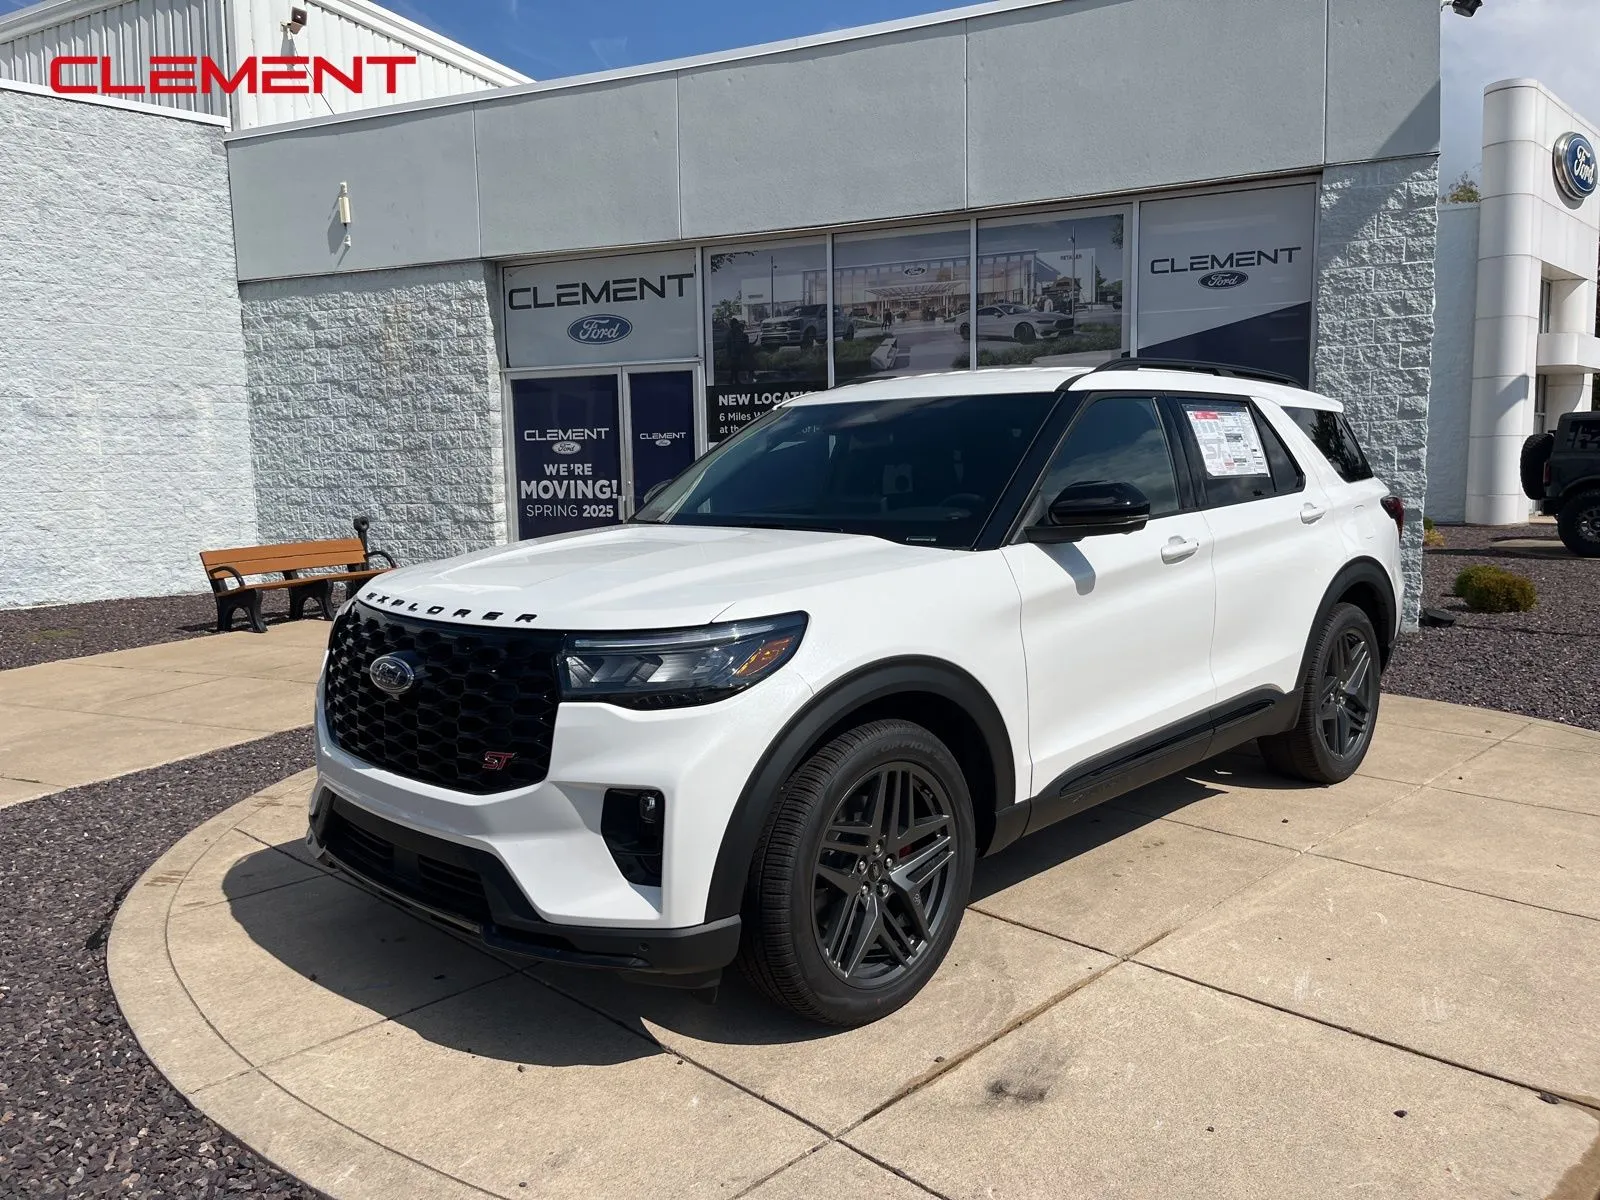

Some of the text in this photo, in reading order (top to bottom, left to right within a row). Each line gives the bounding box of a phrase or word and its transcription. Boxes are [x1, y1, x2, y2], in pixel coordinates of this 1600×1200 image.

[1574, 145, 1595, 185] Ford
[1150, 246, 1302, 275] CLEMENT
[1204, 271, 1238, 288] Ford
[508, 273, 695, 310] CLEMENT
[578, 318, 620, 343] Ford
[718, 391, 811, 406] NEW LOCAT
[719, 413, 725, 422] 6
[728, 412, 751, 421] Miles
[524, 428, 609, 441] CLEMENT
[639, 431, 687, 440] CLEMENT
[719, 425, 740, 434] at th
[557, 442, 576, 453] Ford
[543, 463, 593, 477] WE'RE
[520, 479, 619, 500] MOVING!
[526, 504, 614, 518] SPRING 2025
[366, 592, 538, 622] EXPLORER
[482, 751, 514, 770] ST
